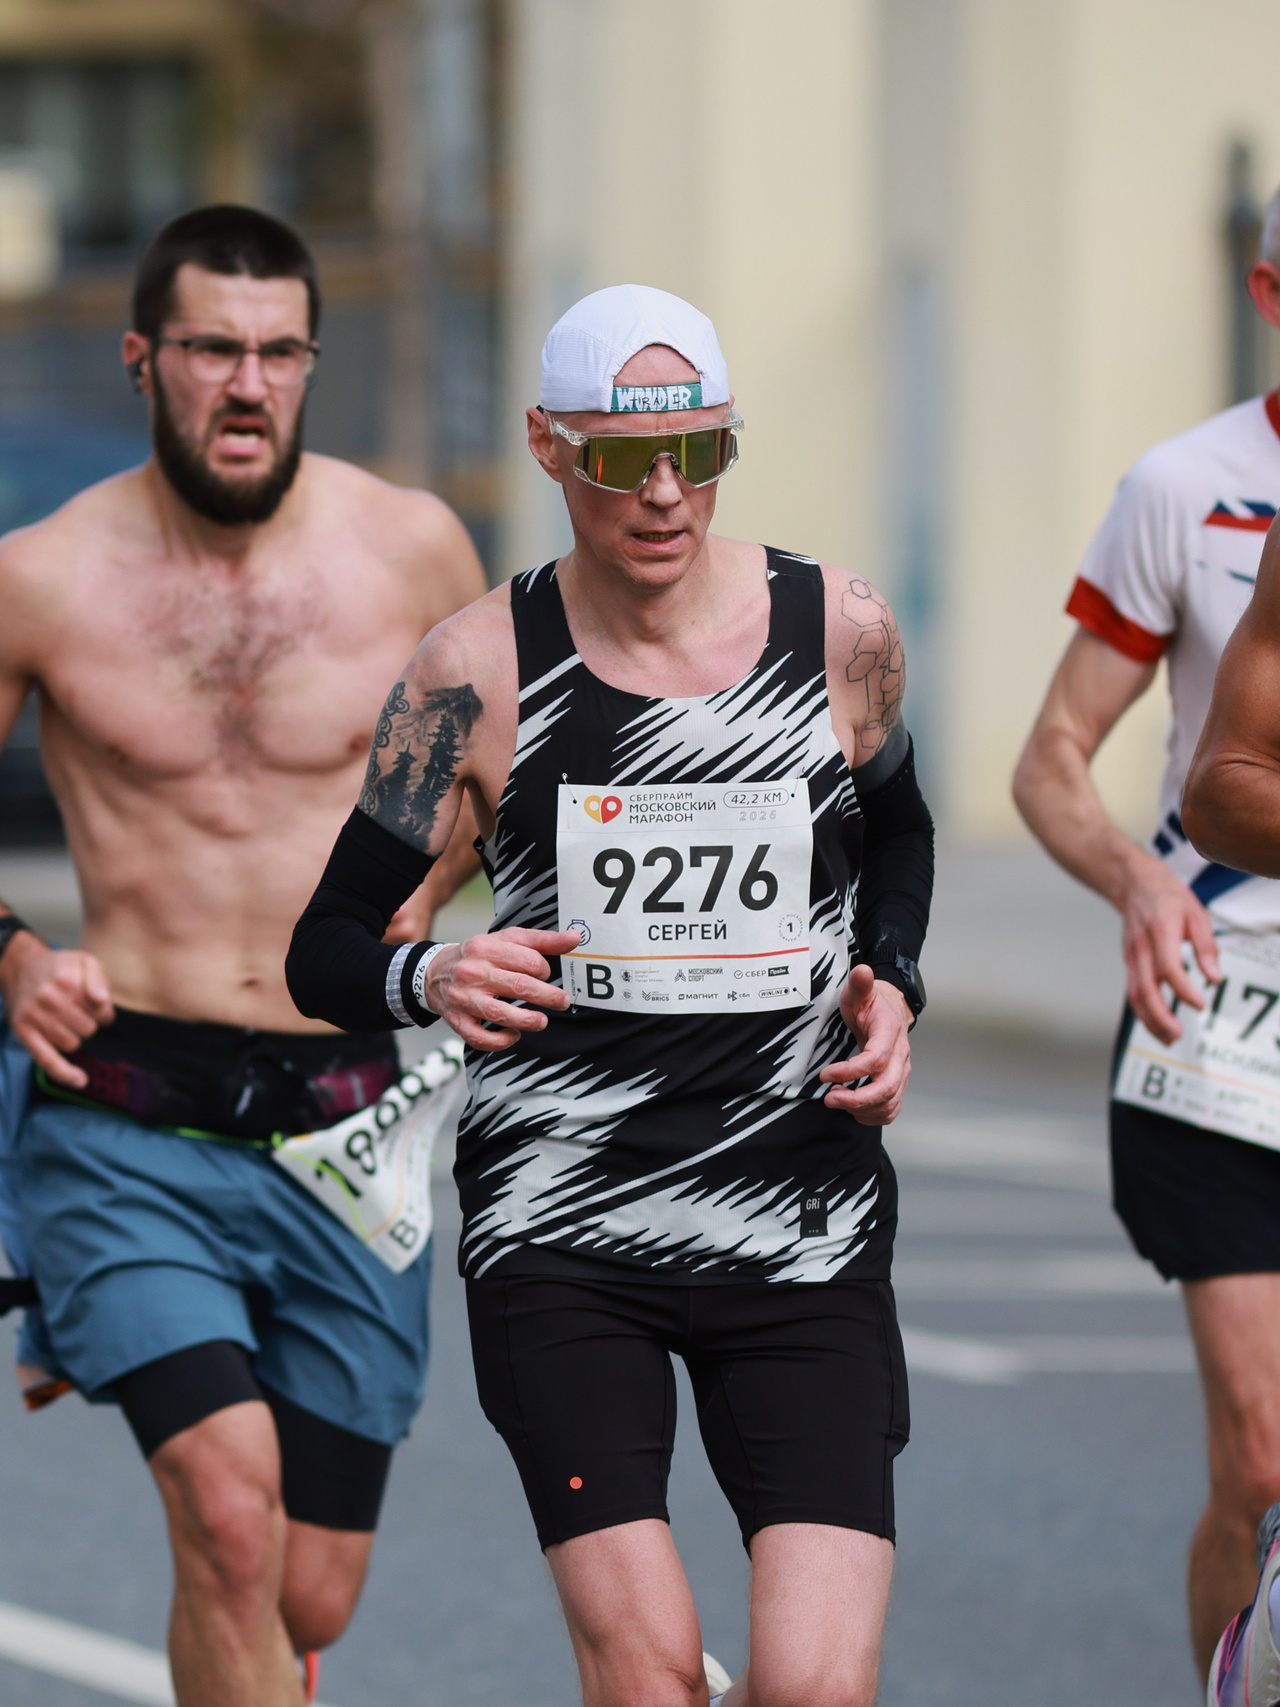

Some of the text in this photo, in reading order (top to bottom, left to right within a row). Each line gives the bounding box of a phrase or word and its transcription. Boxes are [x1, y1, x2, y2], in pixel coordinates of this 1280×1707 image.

[616, 386, 691, 411] WONDER
[630, 792, 692, 802] СБЕРПРАЙМ
[731, 794, 757, 805] 42,2
[629, 800, 716, 813] МОСКОВСКИЙ
[629, 813, 693, 824] МАРАФОН
[739, 811, 777, 821] 2026
[593, 844, 778, 914] 9276
[648, 920, 727, 940] СЕРГЕЙ
[786, 923, 793, 933] 1
[414, 965, 425, 1000] 9276
